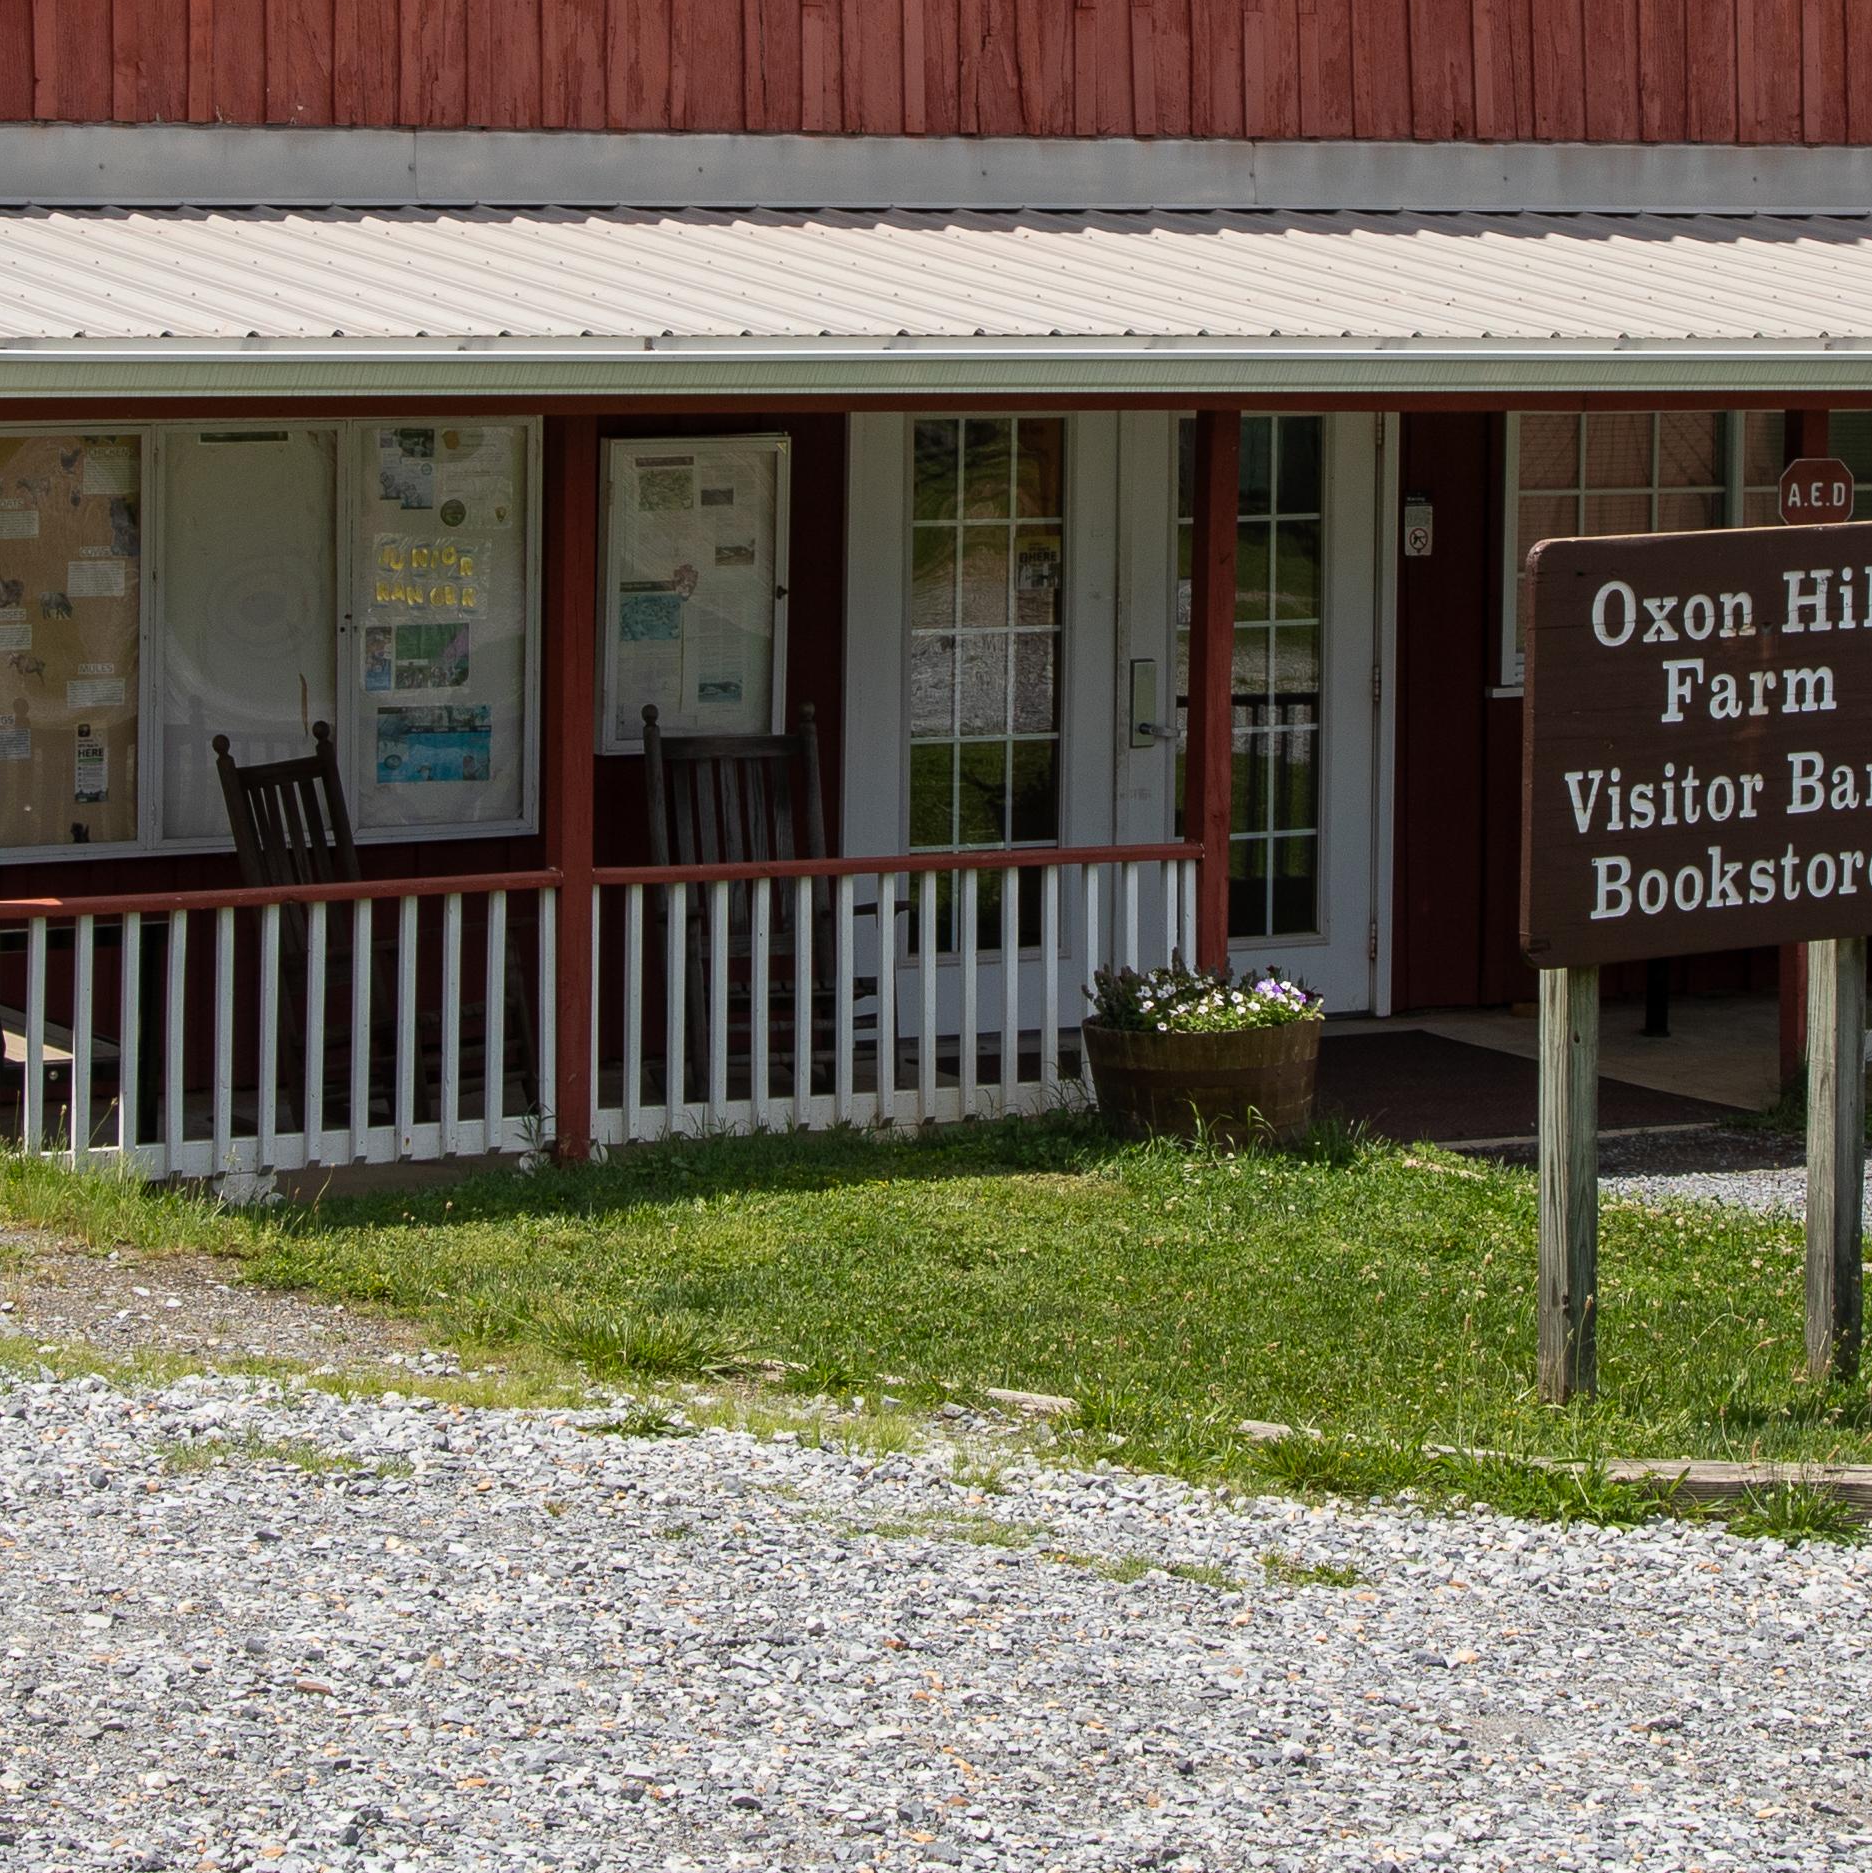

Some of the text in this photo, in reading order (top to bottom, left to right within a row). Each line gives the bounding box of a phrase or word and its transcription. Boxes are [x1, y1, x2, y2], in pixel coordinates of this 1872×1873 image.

[1787, 481, 1847, 508] A.E.D
[375, 582, 478, 607] RANGER
[1591, 580, 1757, 647] Oxon
[79, 664, 114, 673] MULES
[1661, 657, 1838, 723] Farm
[78, 747, 104, 757] HERE
[1563, 761, 1765, 834] Visitor
